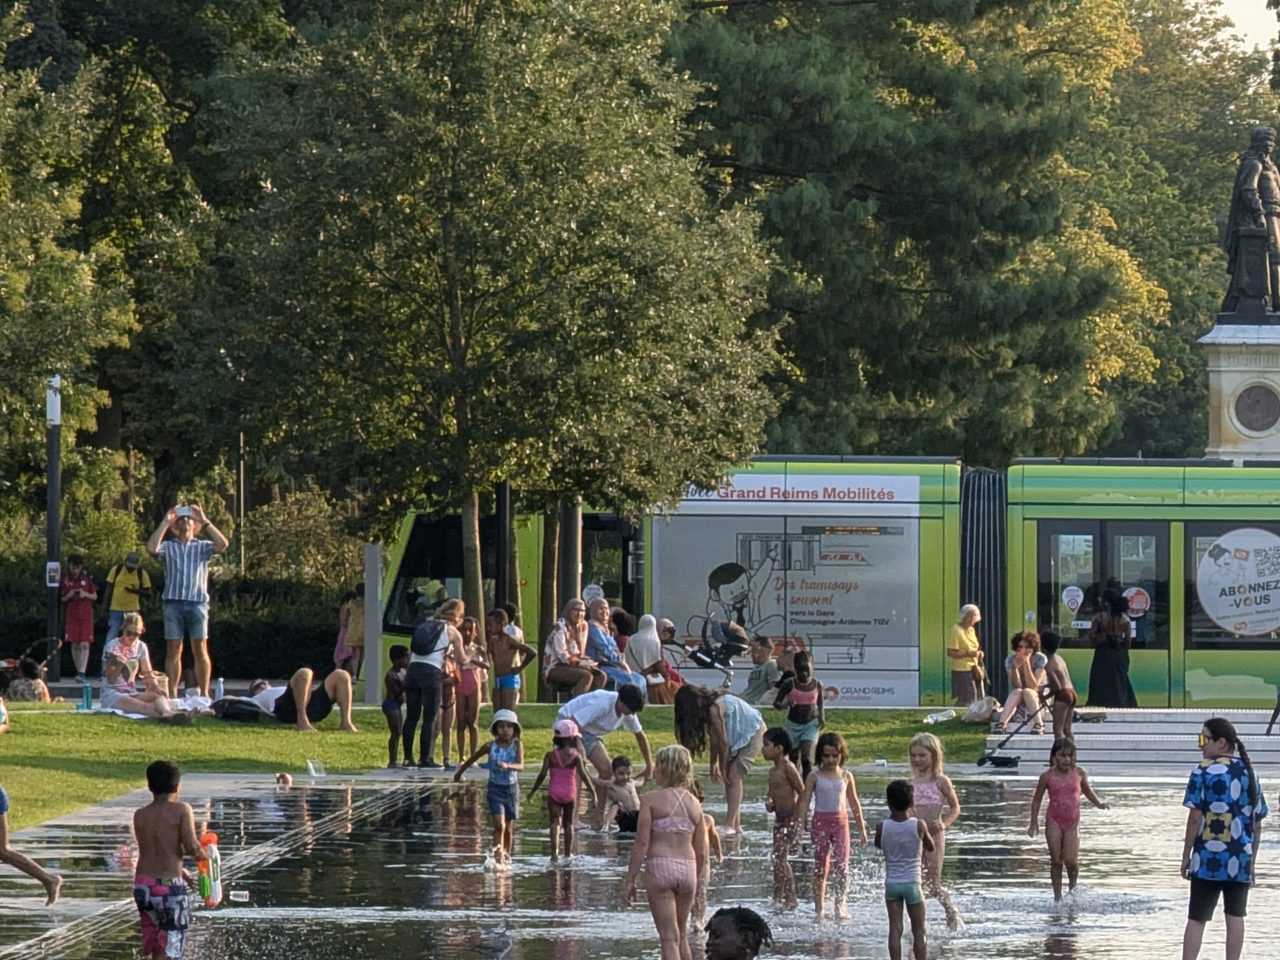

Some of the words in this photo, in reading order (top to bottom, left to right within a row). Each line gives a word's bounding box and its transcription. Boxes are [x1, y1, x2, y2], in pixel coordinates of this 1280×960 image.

[717, 486, 766, 499] Grand
[770, 486, 818, 500] Reims
[822, 486, 895, 501] Mobilités
[1218, 580, 1280, 598] ABONNEZ
[1229, 594, 1272, 610] -VOUS
[840, 686, 869, 695] GRAND
